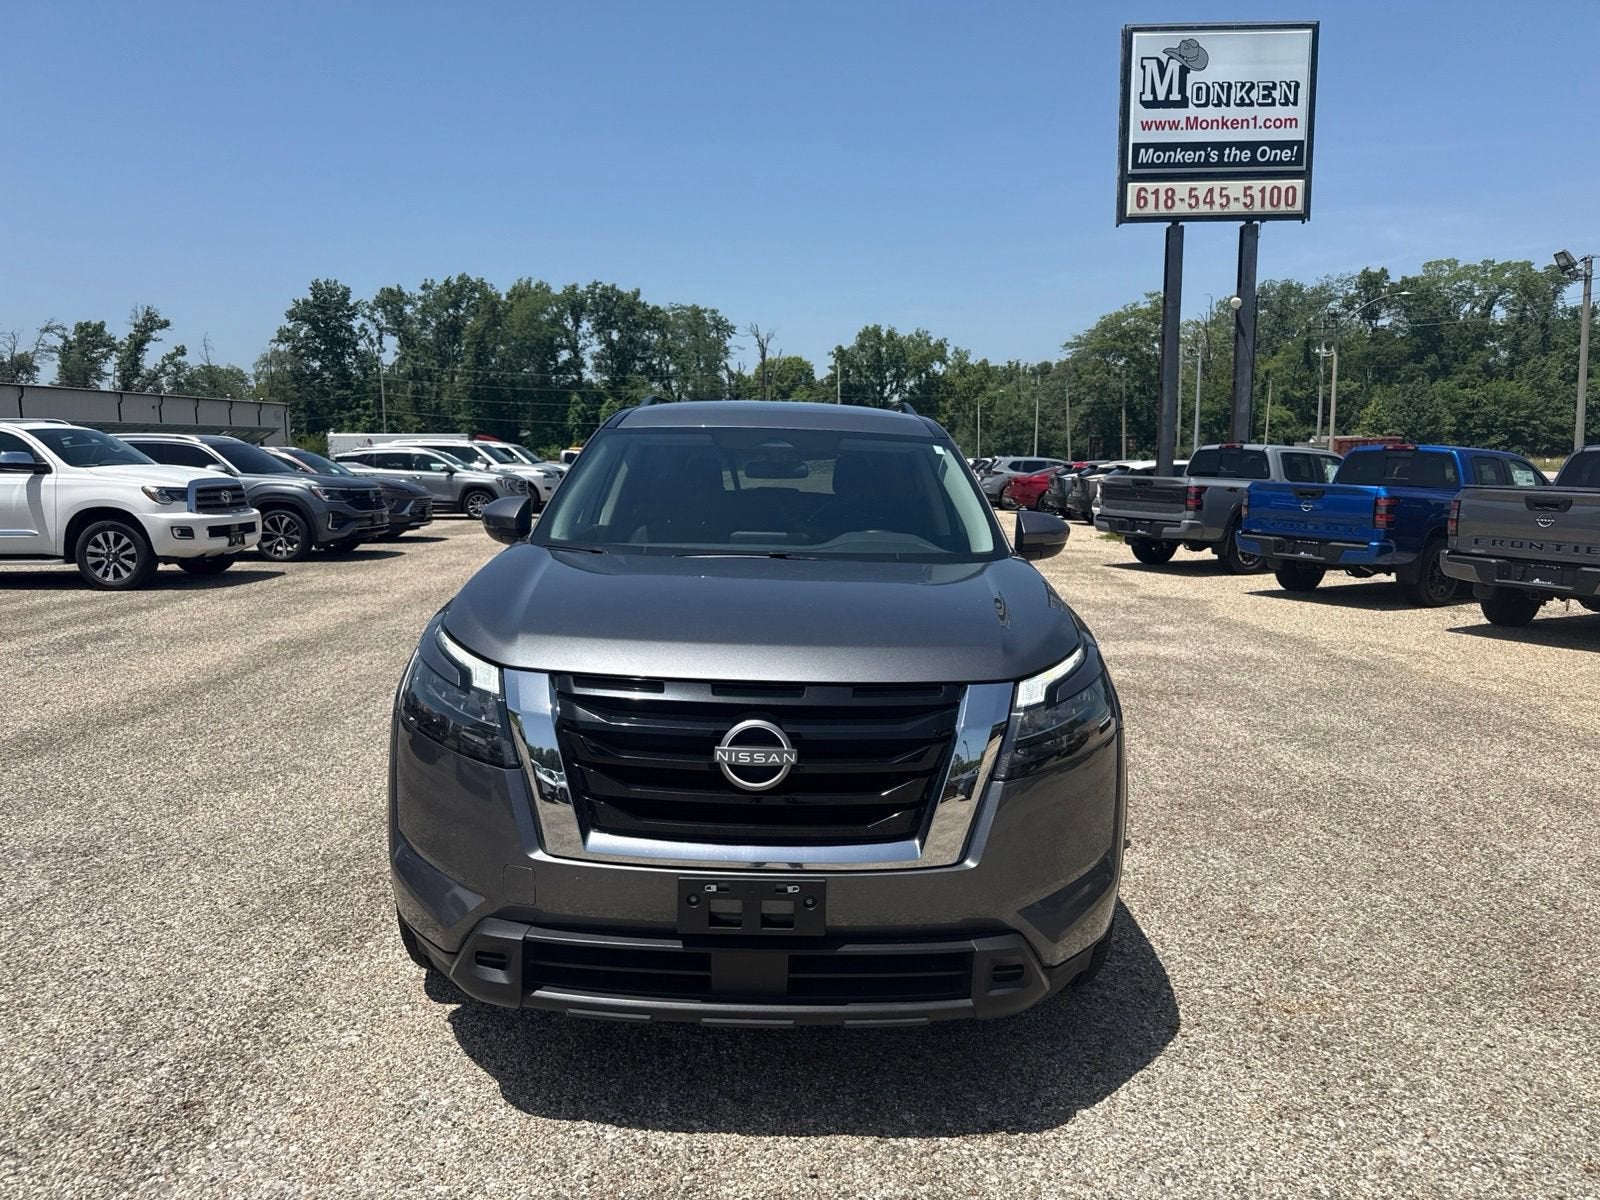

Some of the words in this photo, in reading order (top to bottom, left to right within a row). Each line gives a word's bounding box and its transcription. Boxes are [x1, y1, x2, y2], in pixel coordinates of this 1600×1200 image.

[1139, 57, 1300, 109] MONKEN
[1140, 115, 1299, 131] www.Monken1.com
[1138, 147, 1219, 164] Monken's
[1223, 147, 1251, 162] the
[1256, 146, 1298, 162] One!
[1135, 185, 1297, 210] 618-545-5100
[716, 750, 796, 763] NISSAN
